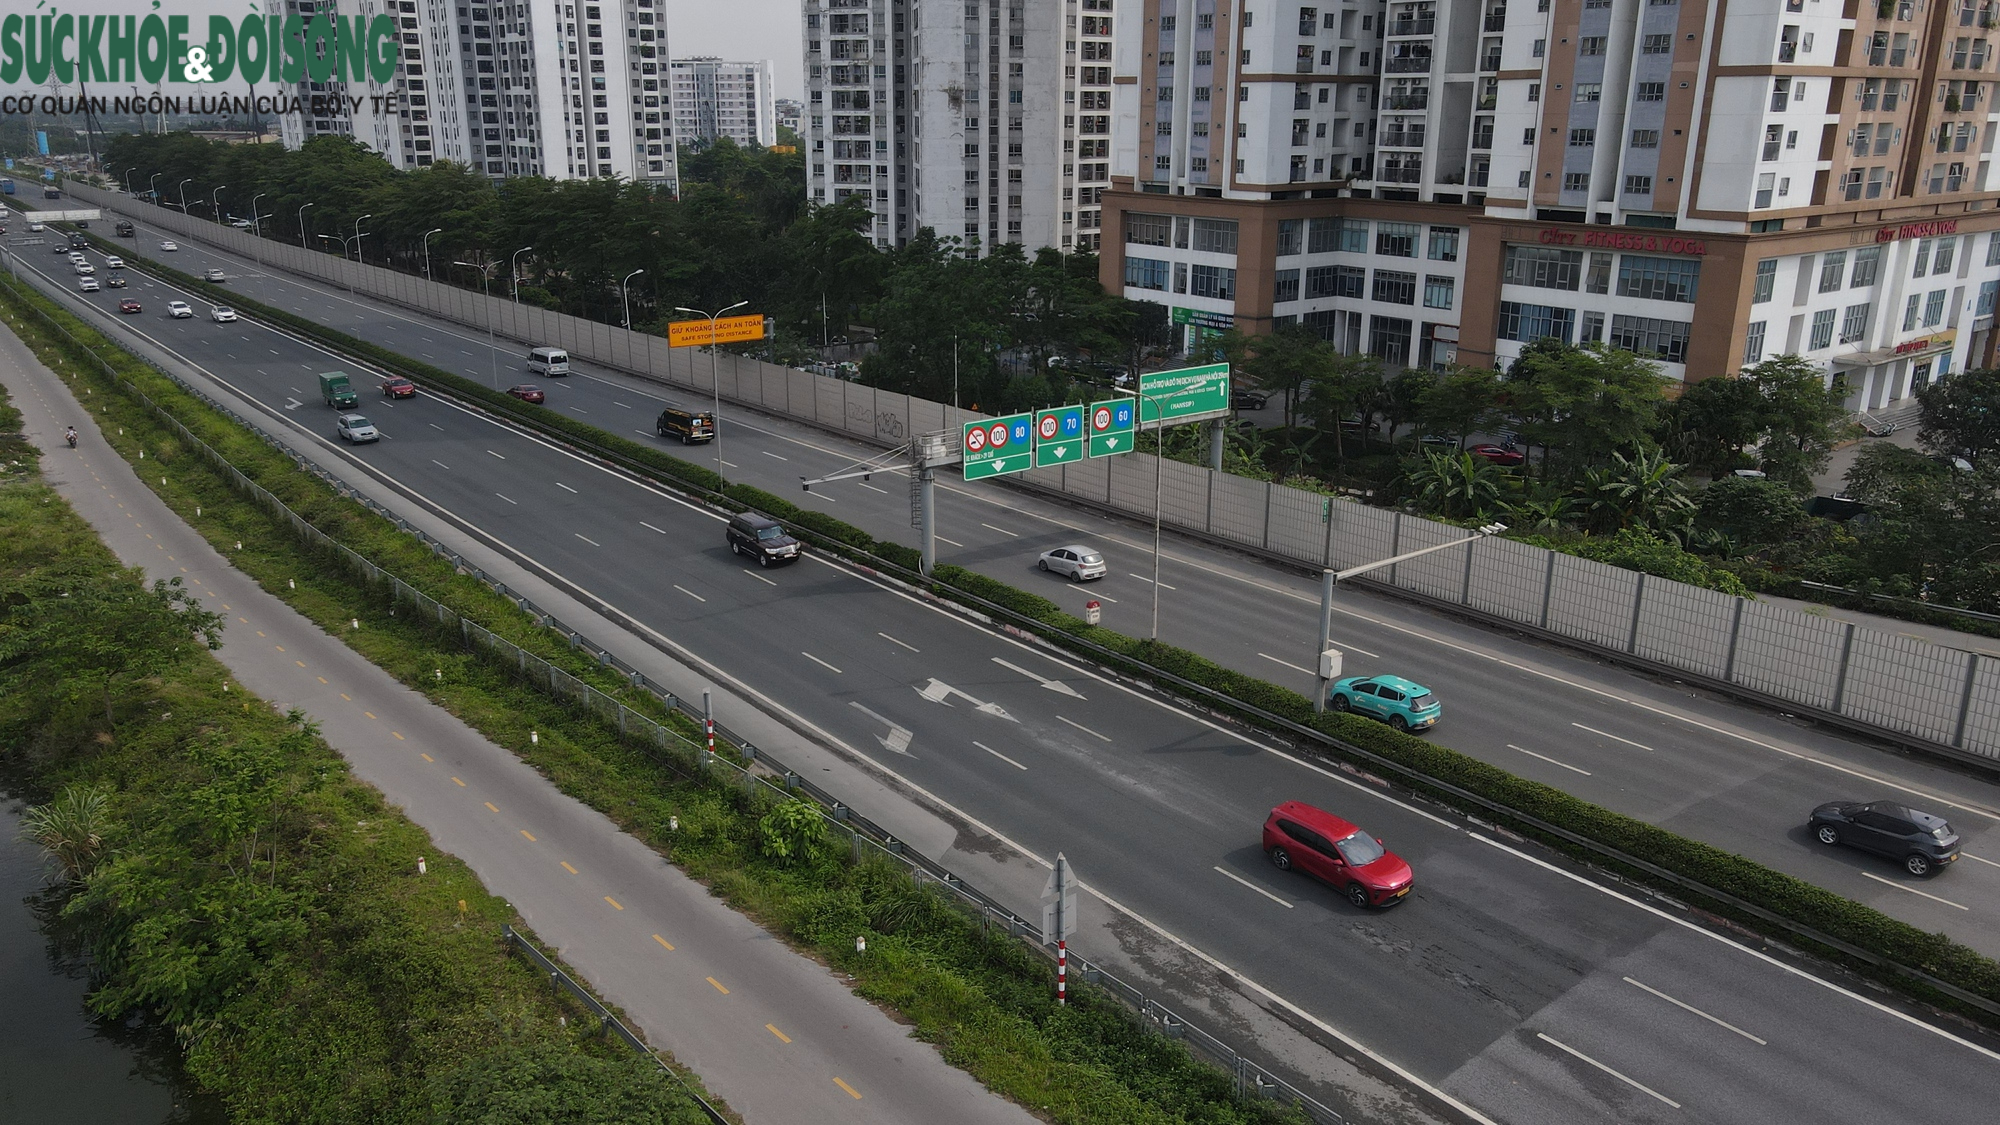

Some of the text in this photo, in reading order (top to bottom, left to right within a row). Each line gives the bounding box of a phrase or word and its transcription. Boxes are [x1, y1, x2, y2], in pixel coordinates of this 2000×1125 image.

[1899, 222, 1929, 240] FITNESS
[1584, 231, 1643, 250] FITNESS
[1645, 236, 1657, 251] &
[1661, 237, 1707, 256] YOGA
[714, 321, 732, 330] CÁCH
[734, 320, 743, 328] AN
[745, 318, 761, 327] TOÀN
[1097, 413, 1107, 424] 100
[1118, 410, 1128, 421] 60
[1043, 421, 1054, 432] 100
[1066, 418, 1077, 430] 70
[993, 430, 1005, 441] 100
[1015, 426, 1025, 438] 80
